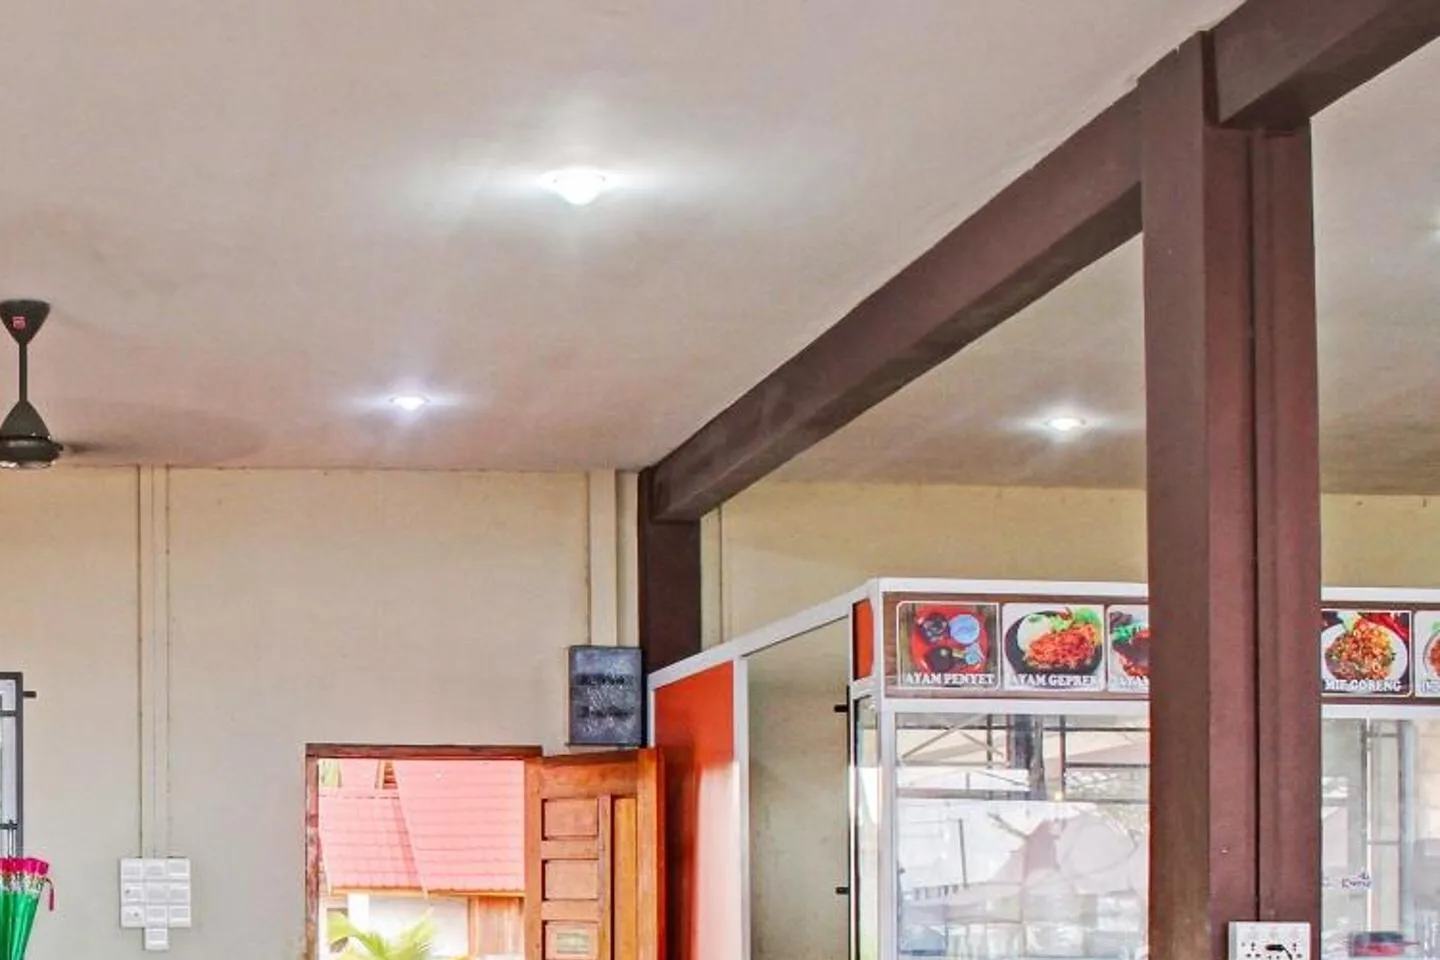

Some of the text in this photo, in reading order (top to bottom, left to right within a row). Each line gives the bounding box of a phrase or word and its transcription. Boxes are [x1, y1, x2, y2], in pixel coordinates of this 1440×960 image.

[905, 672, 995, 685] AYAM PENYET
[1008, 673, 1046, 686] AYAM
[1349, 680, 1402, 691] GORENG
